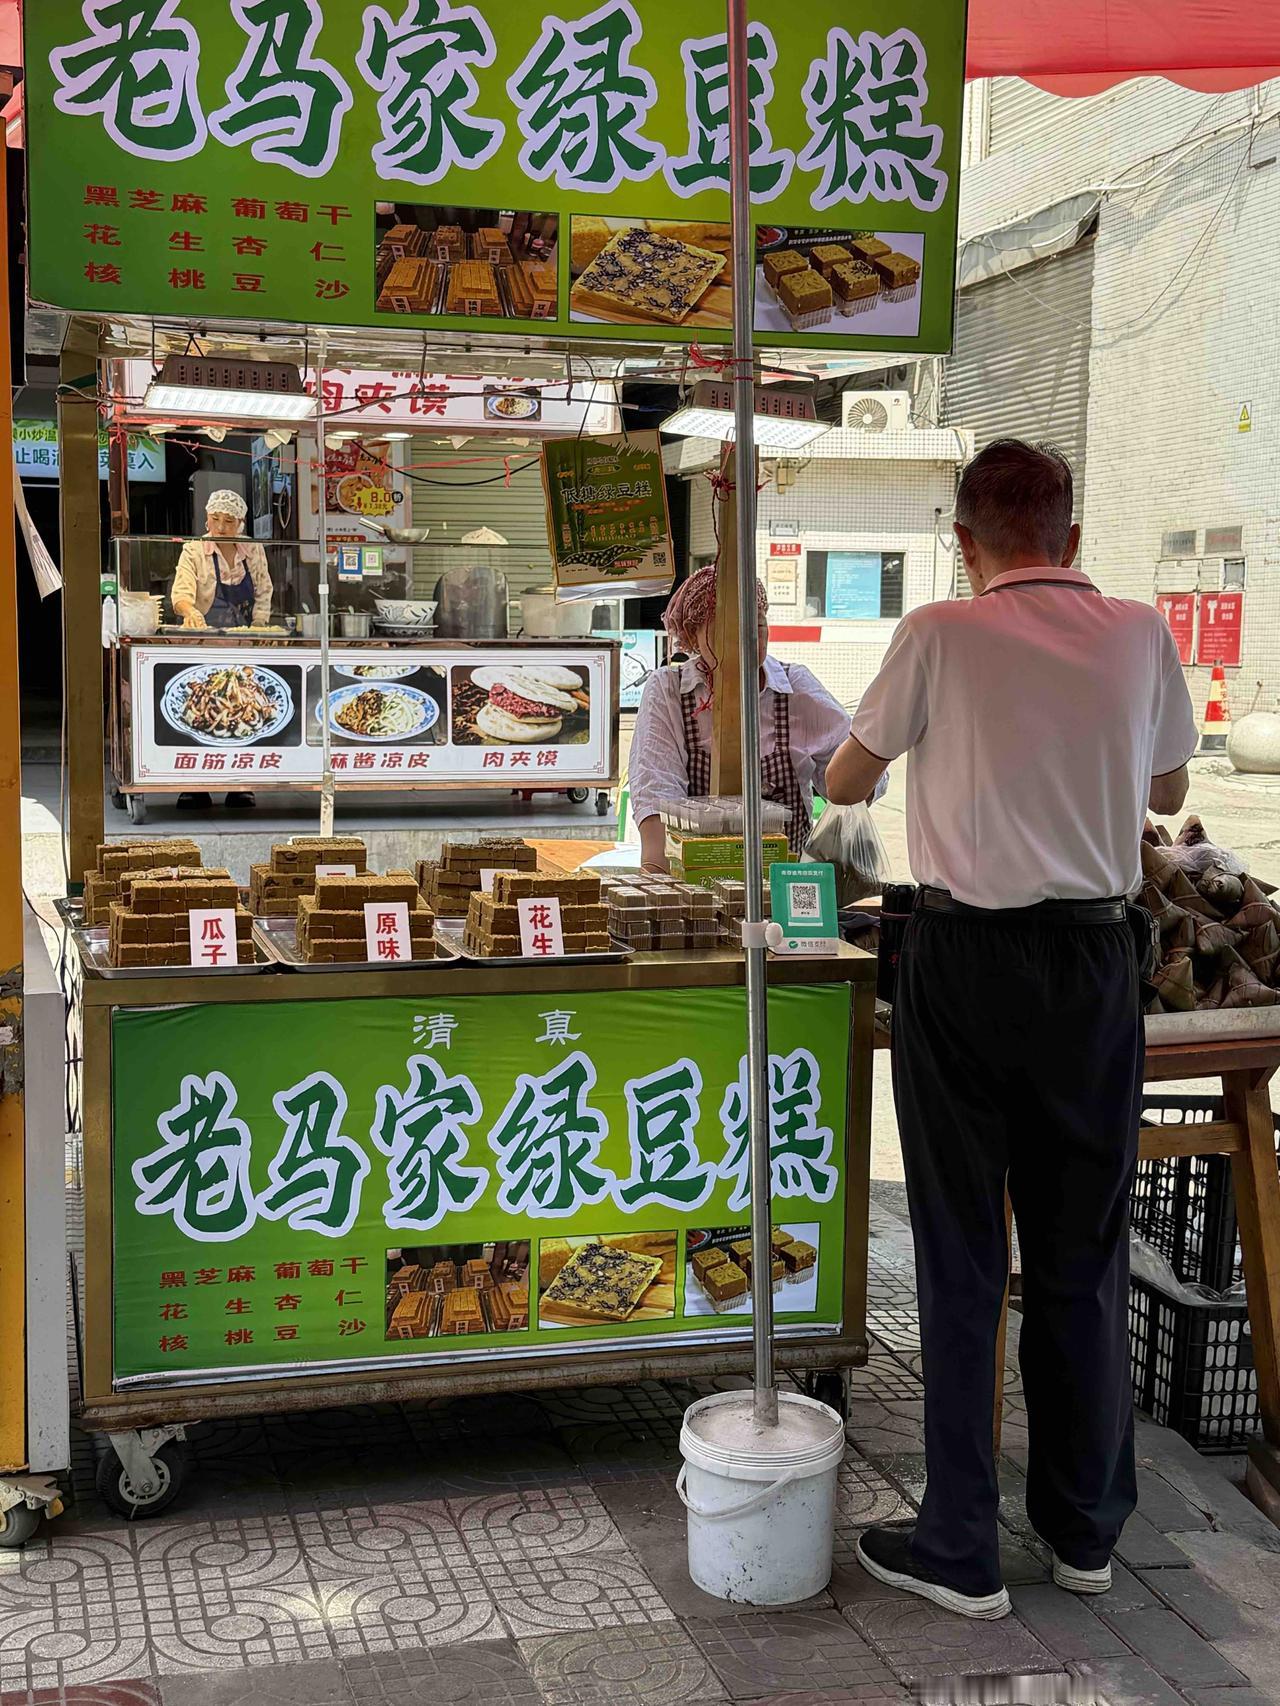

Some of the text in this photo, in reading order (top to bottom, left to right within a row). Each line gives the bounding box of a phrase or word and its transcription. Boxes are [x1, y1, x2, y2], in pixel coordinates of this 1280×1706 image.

[50, 0, 946, 212] 老马家绿豆糕
[84, 185, 352, 225] 黑芝麻 葡萄干
[304, 380, 452, 416] 肉夹馍
[174, 753, 283, 770] 面筋凉皮
[329, 752, 431, 769] 麻酱凉皮
[482, 750, 559, 767] 肉夹馍
[201, 918, 227, 965] 瓜子
[375, 912, 402, 960] 原味
[528, 905, 556, 956] 花生
[132, 1050, 839, 1243] 老马家绿豆糕
[159, 1257, 369, 1288] 黑芝麻 葡萄干
